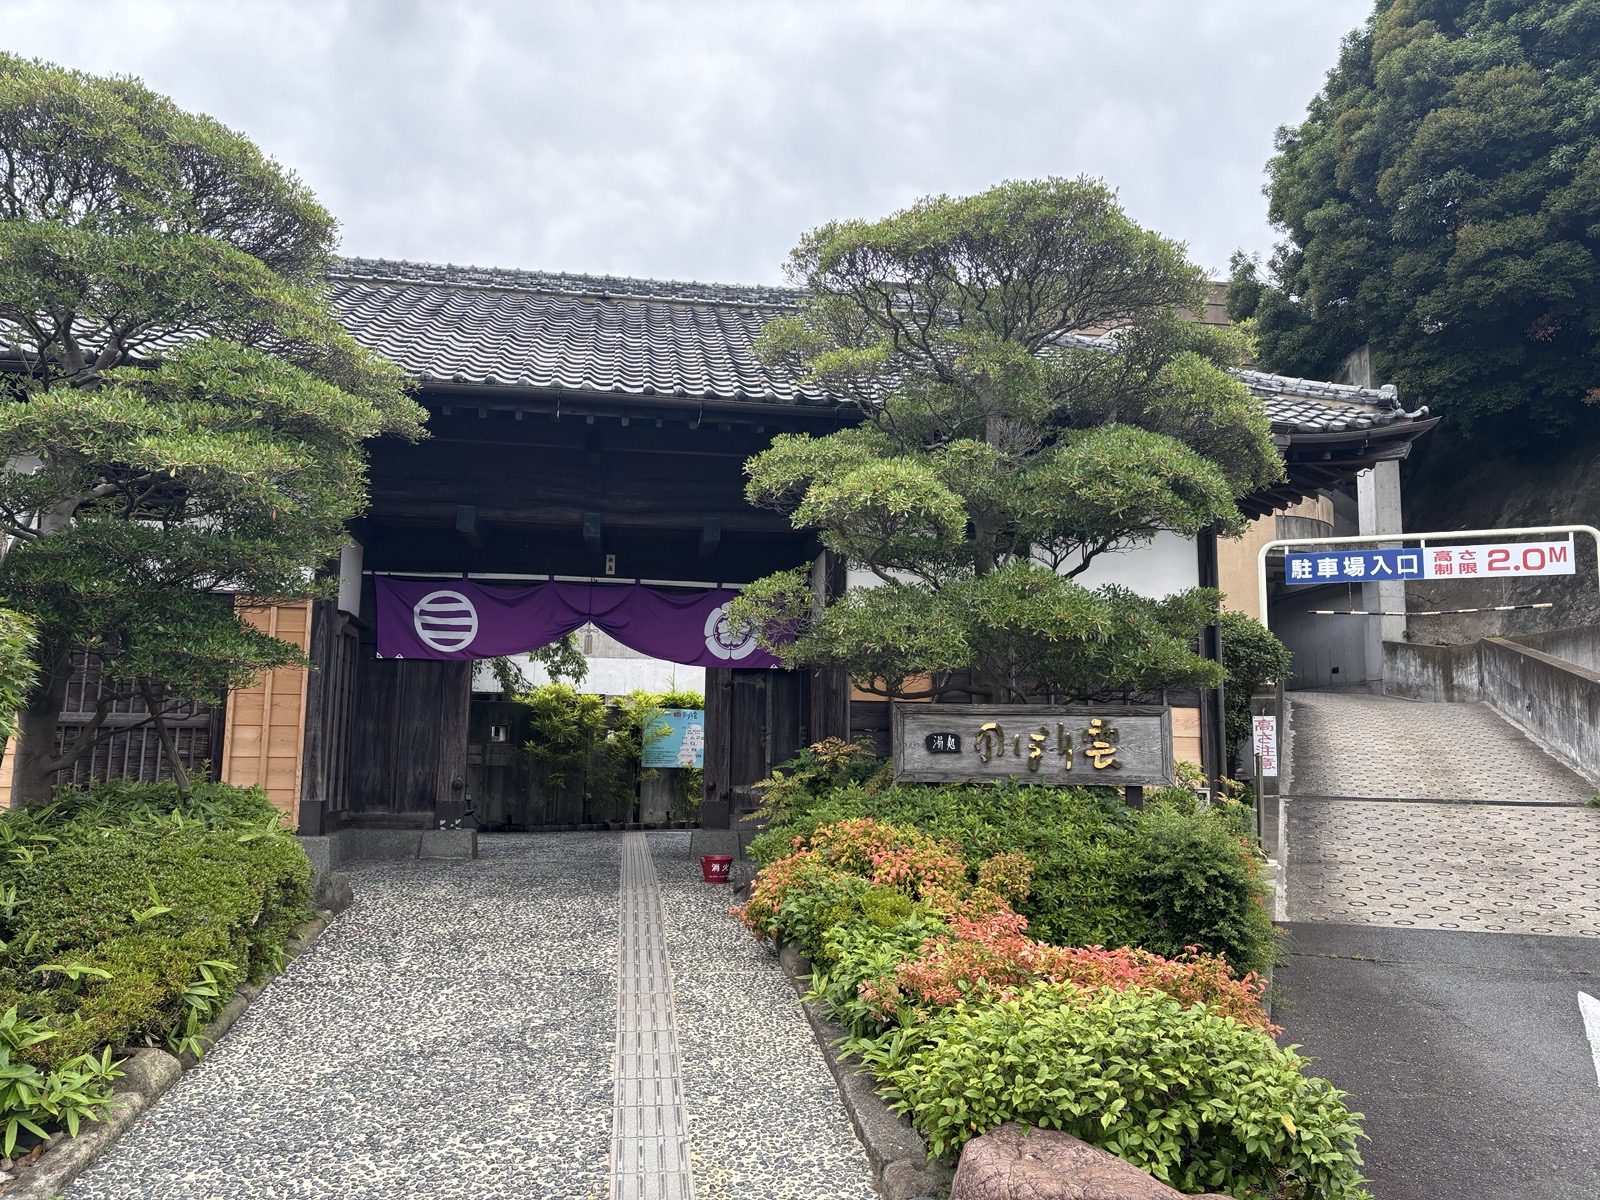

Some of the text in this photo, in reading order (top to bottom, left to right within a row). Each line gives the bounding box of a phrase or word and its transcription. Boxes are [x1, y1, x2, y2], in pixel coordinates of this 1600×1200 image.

[1433, 550, 1477, 562] 高さ
[1487, 547, 1567, 571] 2.0M
[1291, 554, 1418, 579] 駐車場入口
[1433, 563, 1478, 575] 制限
[711, 863, 730, 872] 消火
